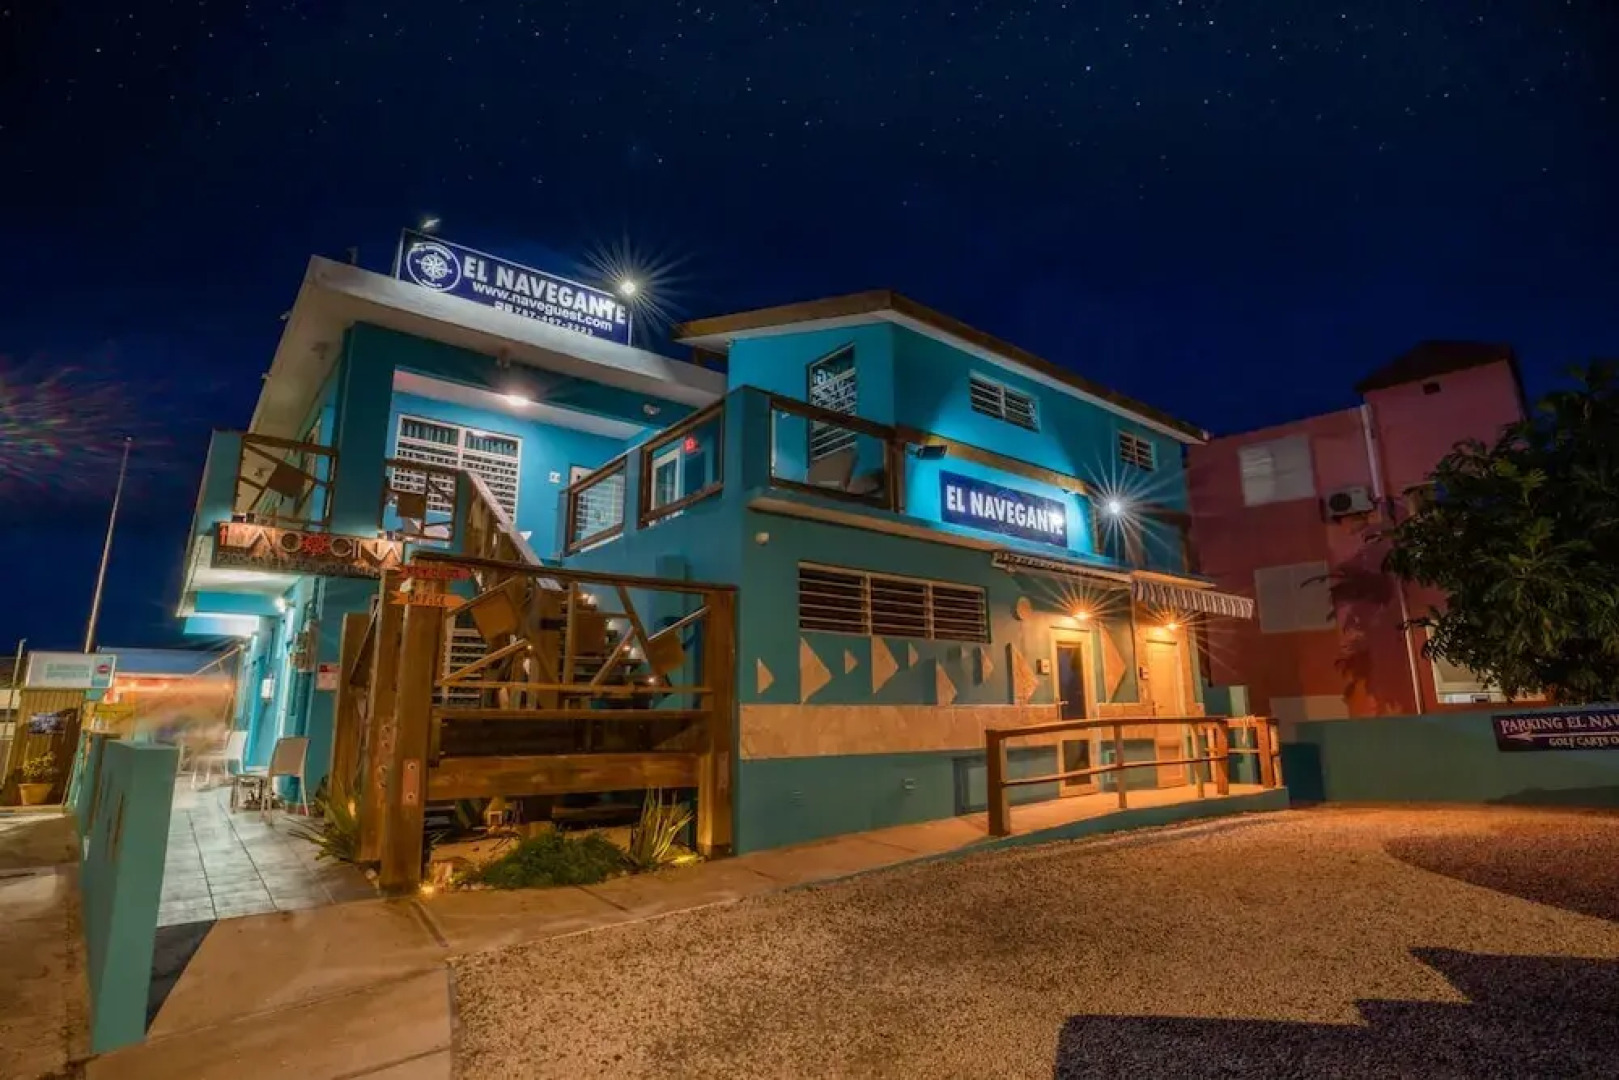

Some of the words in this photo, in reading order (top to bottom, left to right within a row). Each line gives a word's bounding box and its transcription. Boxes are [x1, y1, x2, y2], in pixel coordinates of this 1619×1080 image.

[463, 256, 488, 282] EL
[496, 266, 626, 325] NAVEGANTE
[946, 484, 966, 512] EL
[970, 491, 1064, 535] NAVEGANTE
[1500, 717, 1563, 735] PARKING
[1566, 716, 1587, 729] EL
[1576, 736, 1609, 748] CARTS
